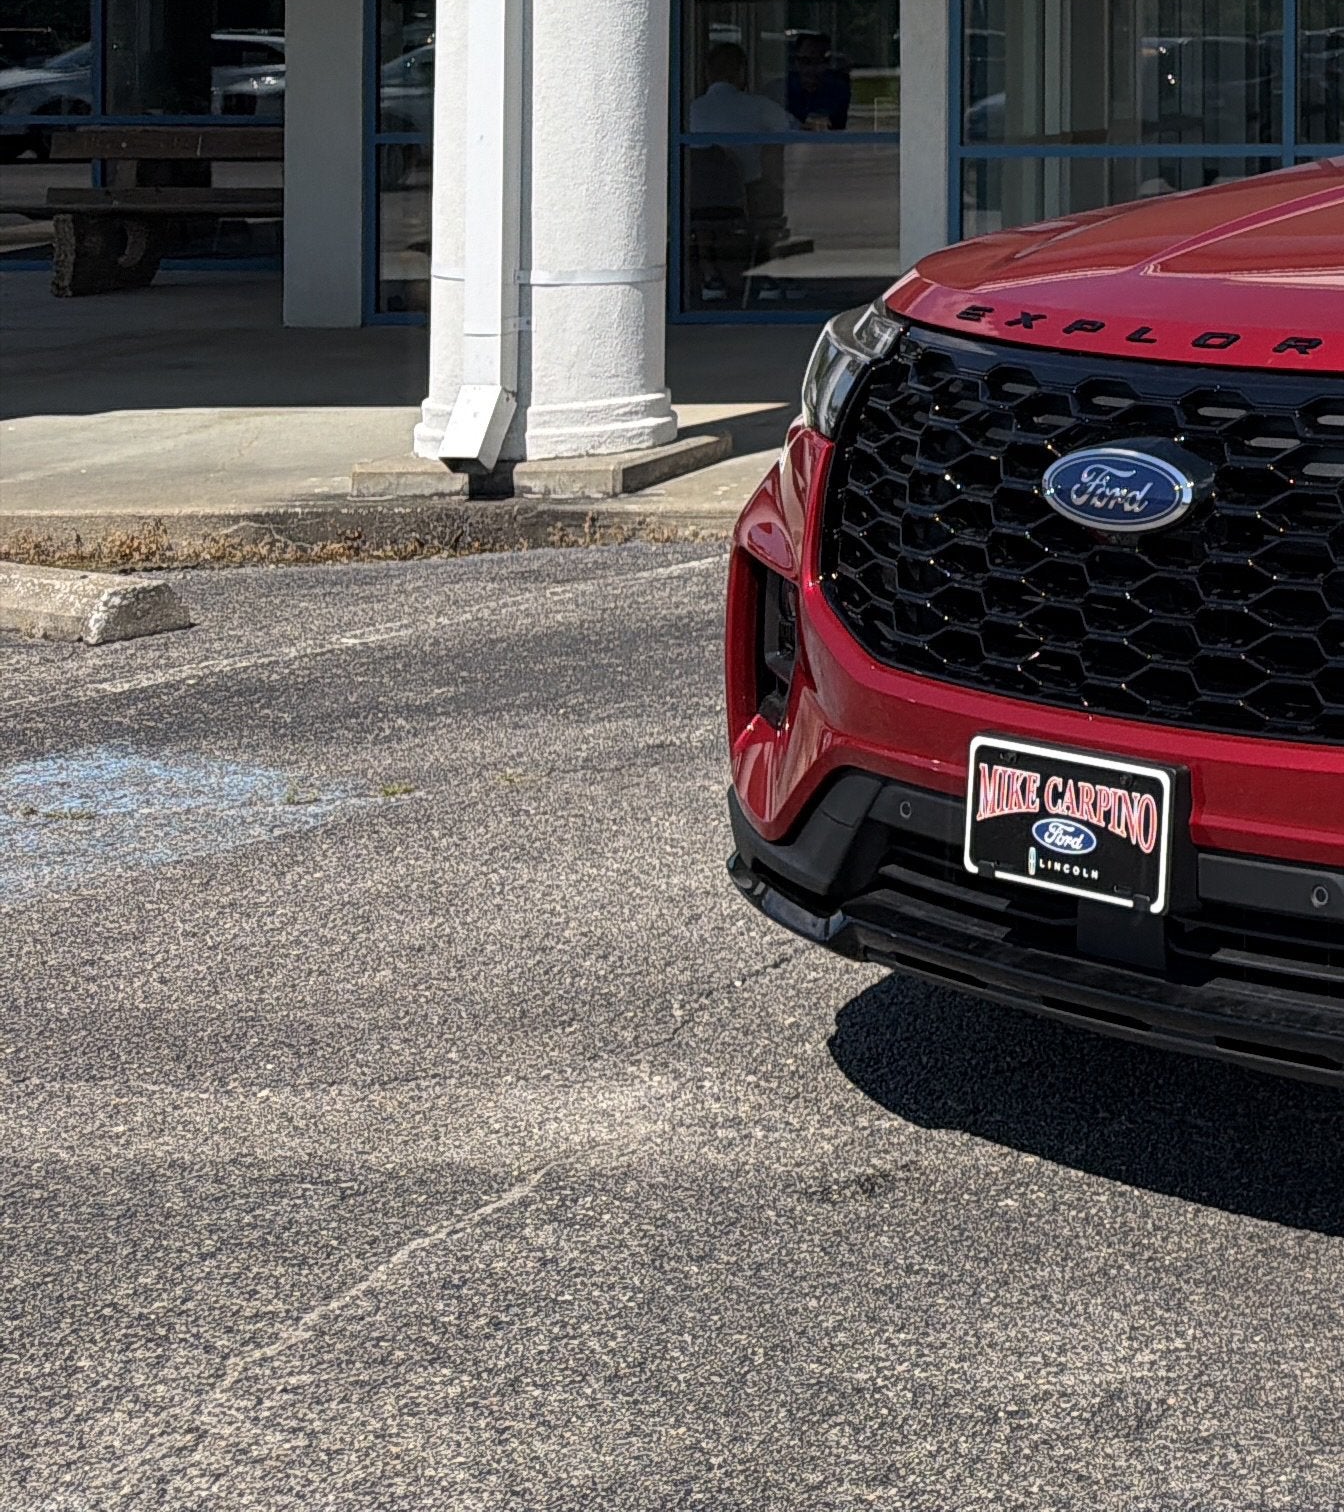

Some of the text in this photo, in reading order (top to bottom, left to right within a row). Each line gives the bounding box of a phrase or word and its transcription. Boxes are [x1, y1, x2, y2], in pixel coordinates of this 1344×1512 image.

[1070, 463, 1154, 513] Ford
[976, 763, 1158, 854] MIKE CARPINO
[1043, 821, 1085, 851] Ford
[1038, 858, 1099, 881] LINCOLN
